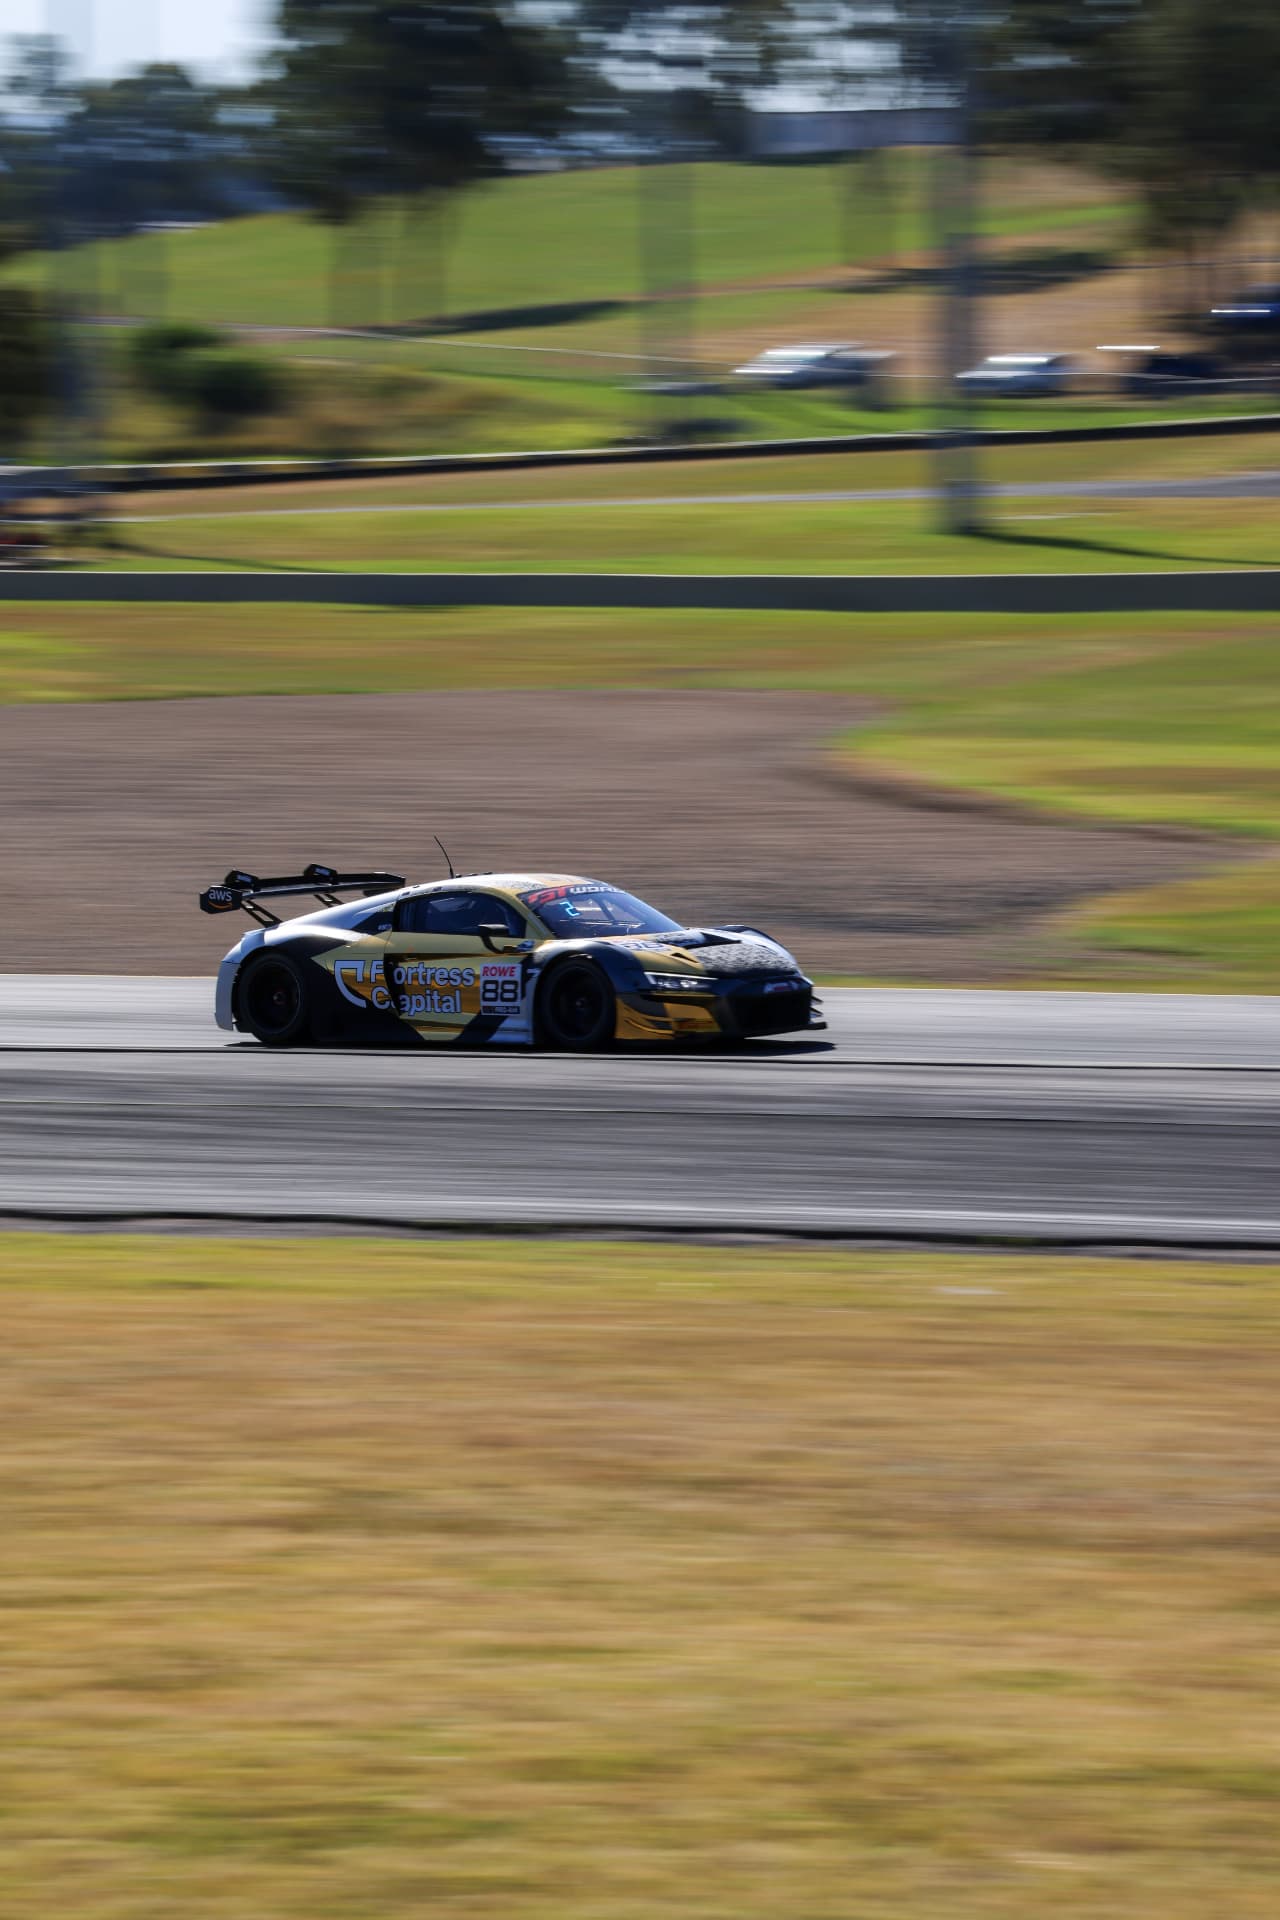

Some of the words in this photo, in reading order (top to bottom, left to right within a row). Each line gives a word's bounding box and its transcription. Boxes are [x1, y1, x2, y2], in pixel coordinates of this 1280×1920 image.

[208, 888, 233, 902] aws
[369, 959, 475, 986] Fortress
[482, 966, 516, 977] ROWE
[371, 985, 462, 1016] Capital
[481, 979, 519, 1002] 88
